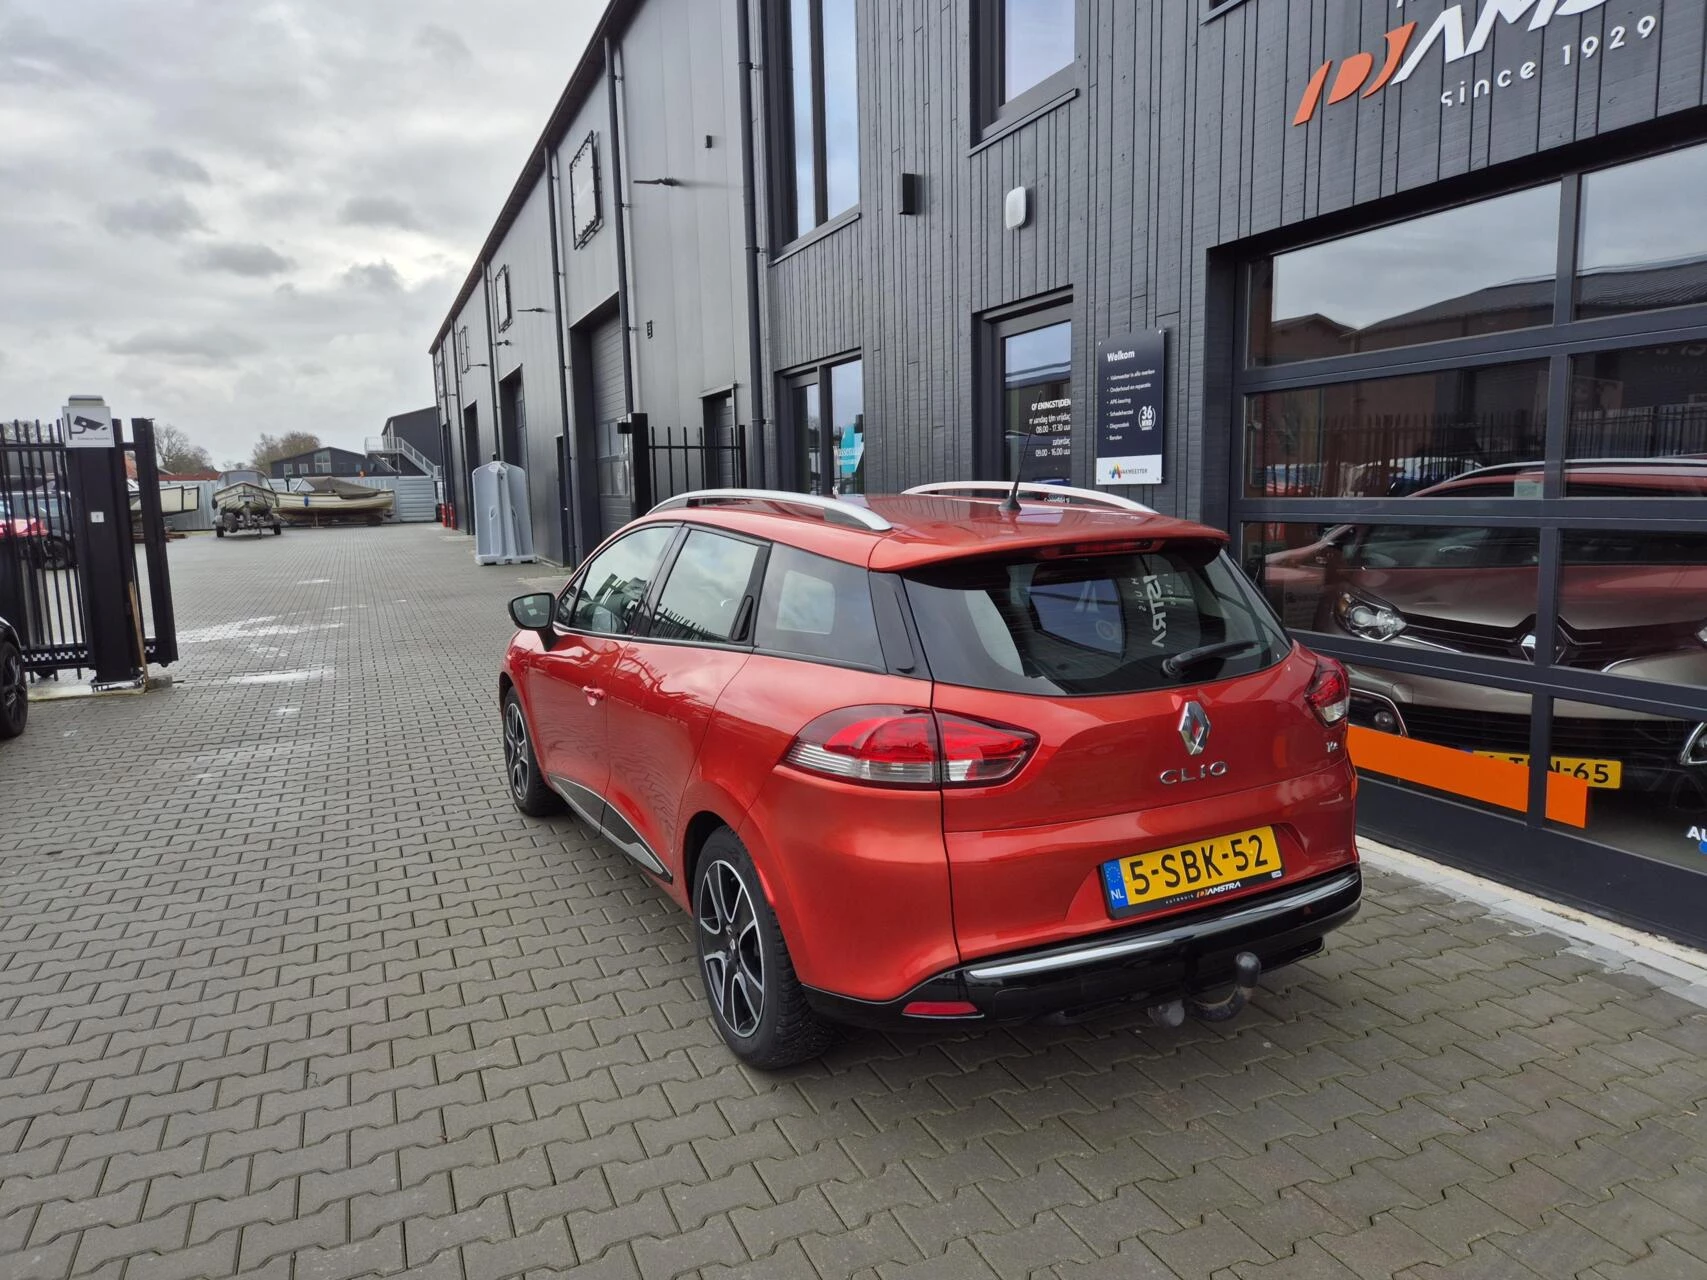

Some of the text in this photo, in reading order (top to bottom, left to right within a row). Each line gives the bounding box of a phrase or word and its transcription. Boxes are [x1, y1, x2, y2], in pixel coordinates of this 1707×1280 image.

[1440, 14, 1657, 107] since 1929
[1106, 350, 1135, 363] Welkom
[1141, 405, 1153, 419] 36
[1159, 760, 1229, 785] CLIO
[1129, 834, 1269, 896] 5-SBK-52
[1111, 888, 1125, 900] NL
[1165, 893, 1195, 905] AUTOHUIS
